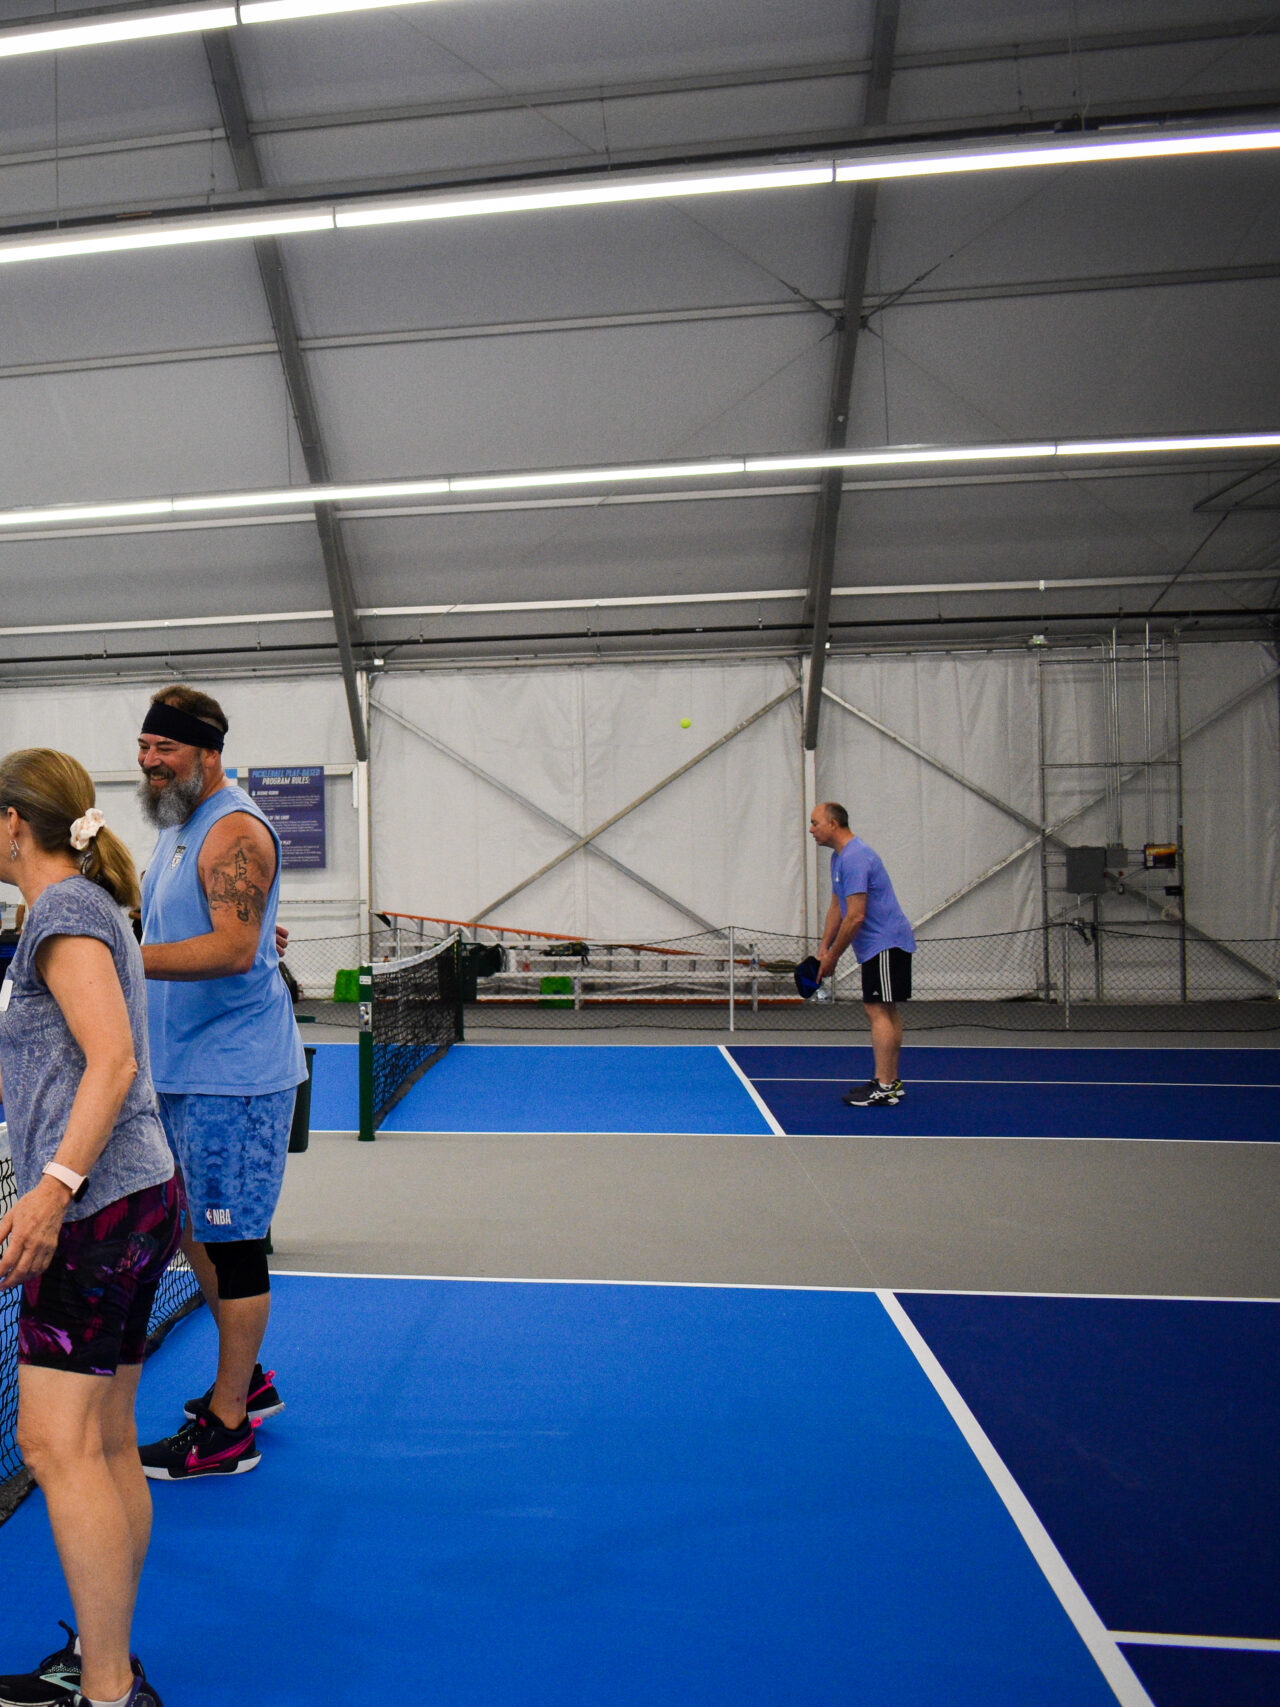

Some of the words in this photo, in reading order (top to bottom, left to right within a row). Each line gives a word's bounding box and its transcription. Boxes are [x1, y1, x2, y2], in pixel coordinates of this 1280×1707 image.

[262, 776, 291, 785] PROGRAM
[291, 776, 311, 785] RULES:
[212, 1208, 232, 1225] NBA
